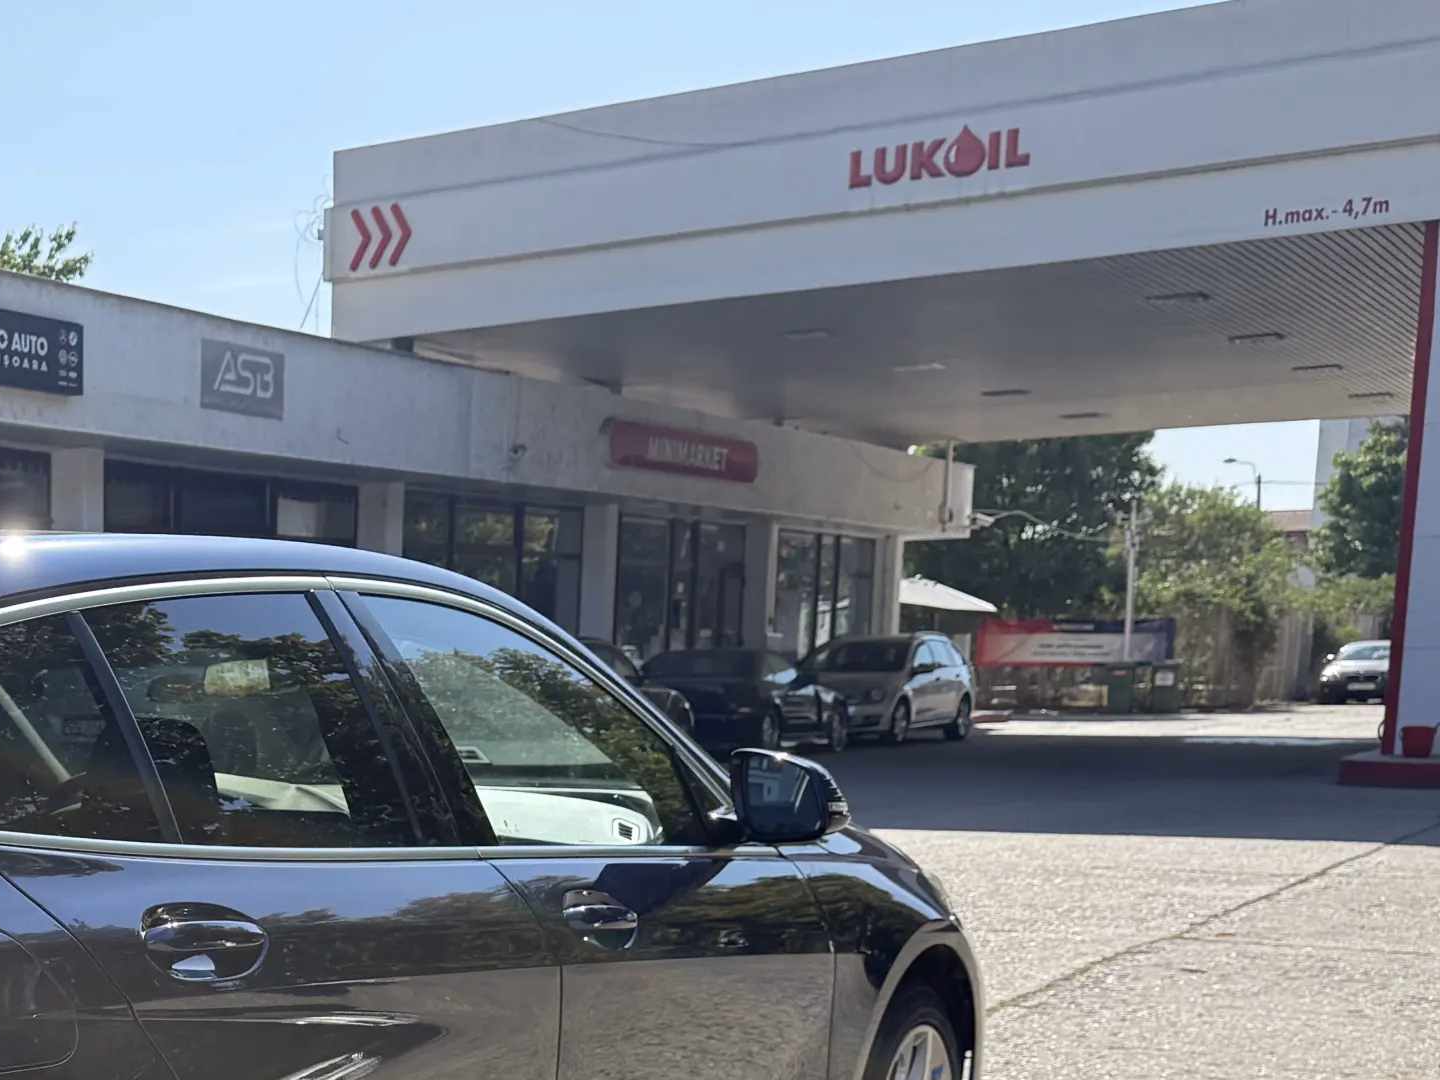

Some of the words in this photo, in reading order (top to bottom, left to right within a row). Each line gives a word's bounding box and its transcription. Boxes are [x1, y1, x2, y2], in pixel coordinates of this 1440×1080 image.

[848, 124, 1031, 190] LUKOIL
[1342, 196, 1390, 220] 4,7m
[10, 331, 49, 357] AUTO
